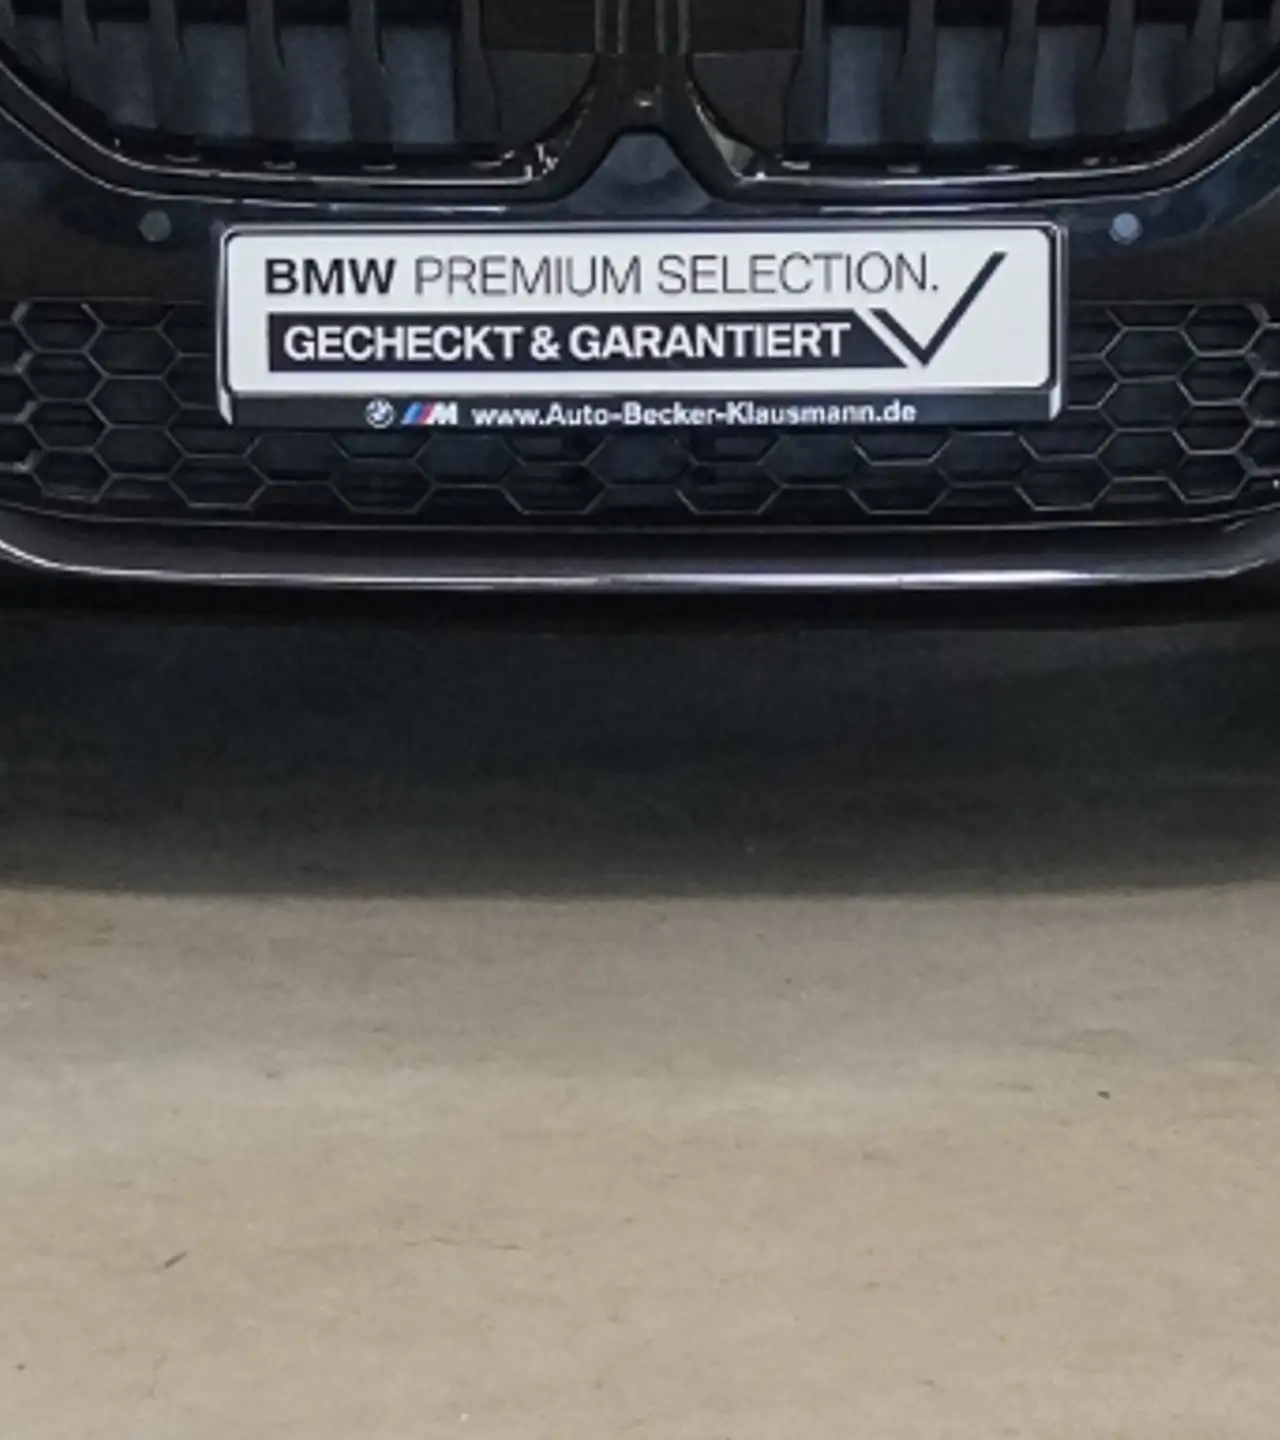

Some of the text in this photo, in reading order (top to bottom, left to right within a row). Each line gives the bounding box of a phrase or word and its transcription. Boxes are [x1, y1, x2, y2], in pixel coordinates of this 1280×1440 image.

[264, 252, 939, 295] BMW PREMIUM SELECTION.
[284, 322, 851, 361] GECHECKT & GARANTIERT
[472, 400, 916, 427] www.Auto-Becker-Klausmann.de
